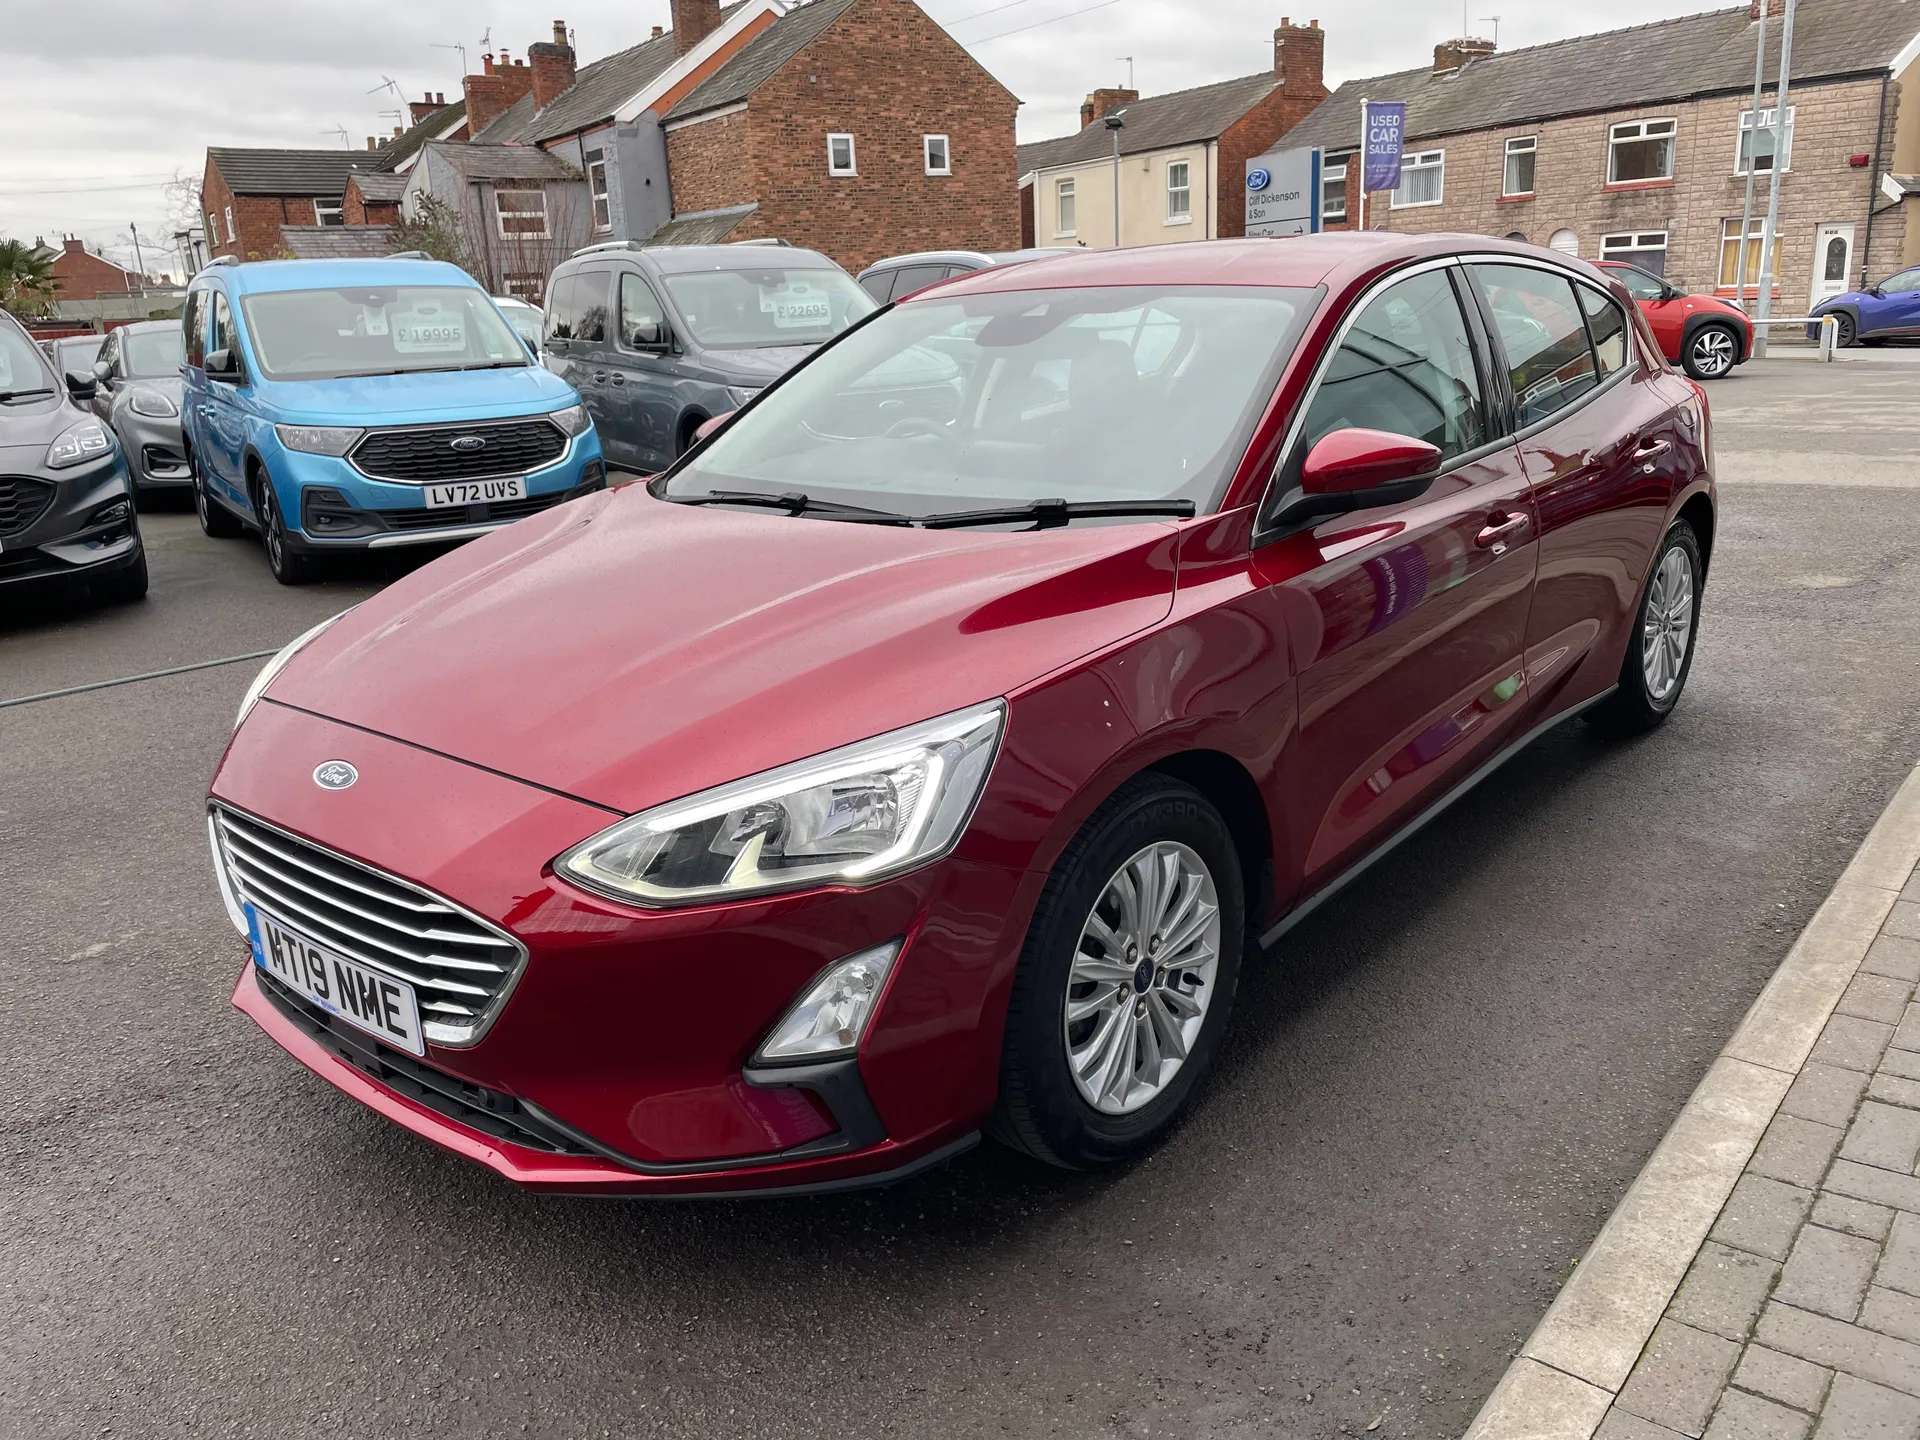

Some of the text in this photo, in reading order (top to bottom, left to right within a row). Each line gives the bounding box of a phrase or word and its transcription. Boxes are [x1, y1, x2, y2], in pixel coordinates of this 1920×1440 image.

[1371, 115, 1400, 127] USED
[1370, 128, 1399, 143] CAR
[1369, 144, 1398, 154] SALES
[1261, 191, 1299, 204] Dickenson
[1254, 208, 1266, 219] Son
[432, 481, 519, 505] LV72 UVS
[320, 765, 349, 785] Ford
[265, 920, 408, 1039] MT19 NME
